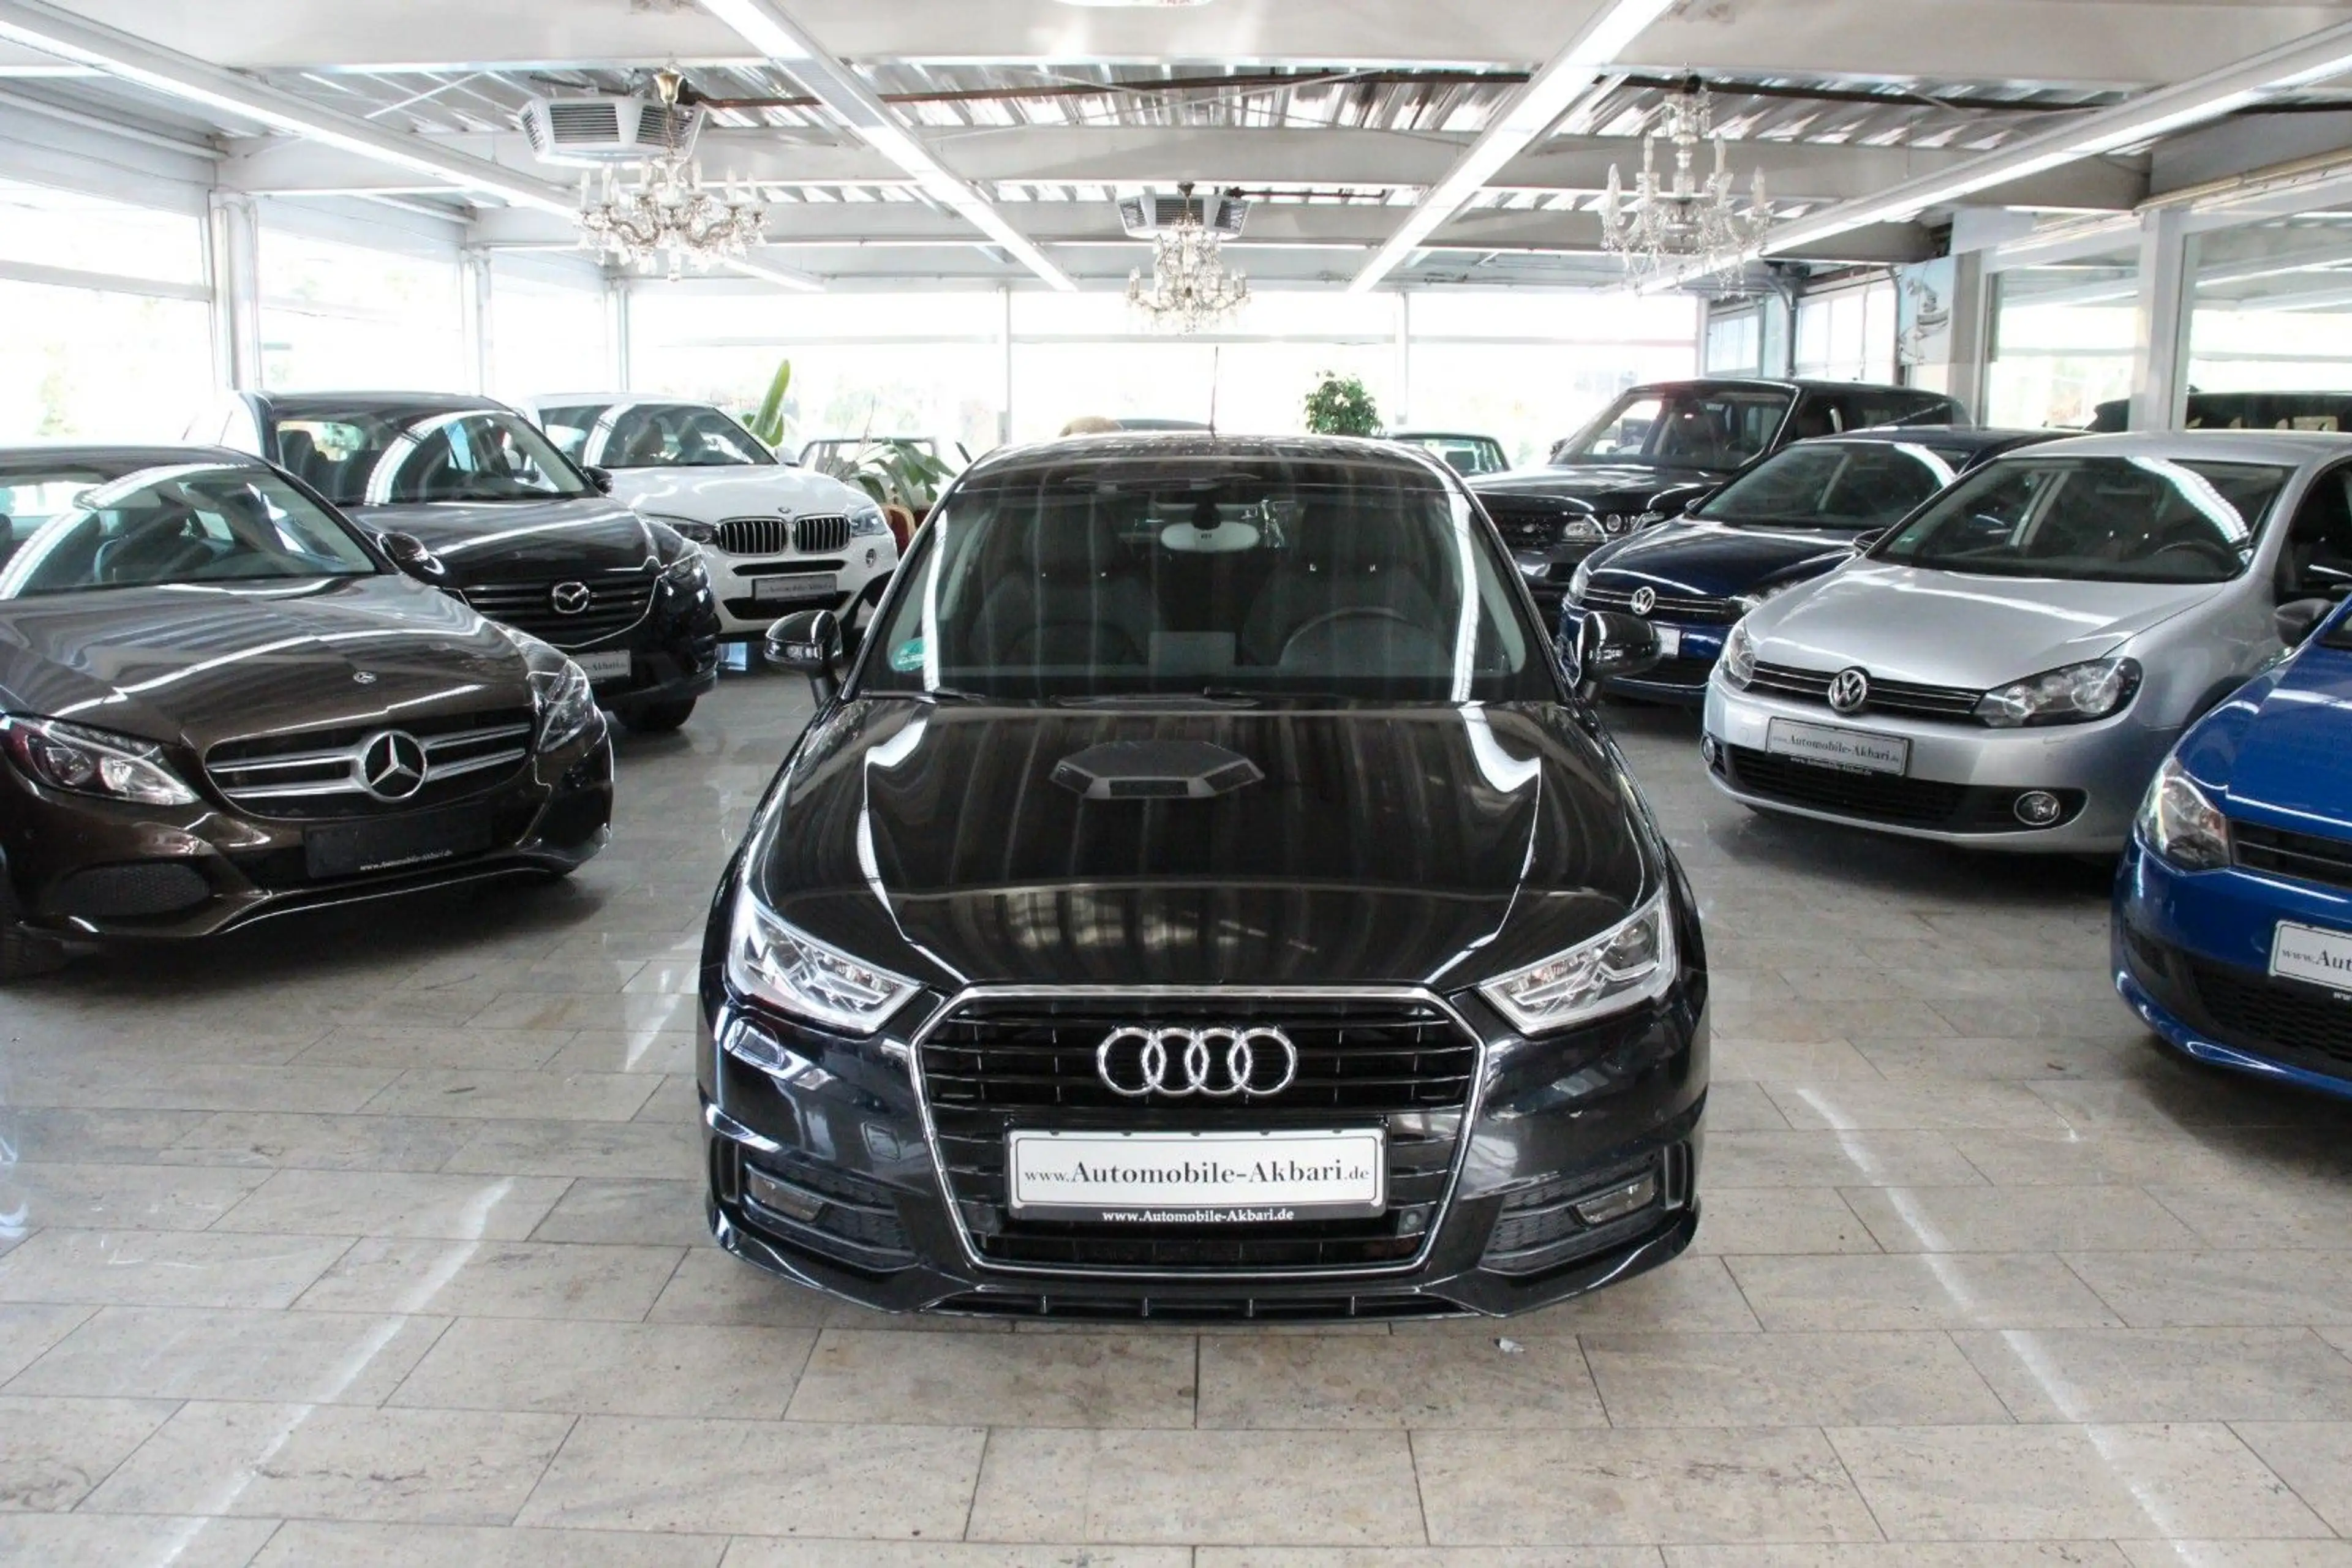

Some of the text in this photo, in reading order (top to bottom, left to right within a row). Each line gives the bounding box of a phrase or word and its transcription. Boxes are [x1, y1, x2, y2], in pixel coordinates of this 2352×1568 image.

[1773, 734, 1899, 762] Automobile-Akbari
[1025, 1159, 1370, 1183] www.Automobile-Akbari.de
[1102, 1208, 1295, 1223] www.Automobile-Akbari.de
